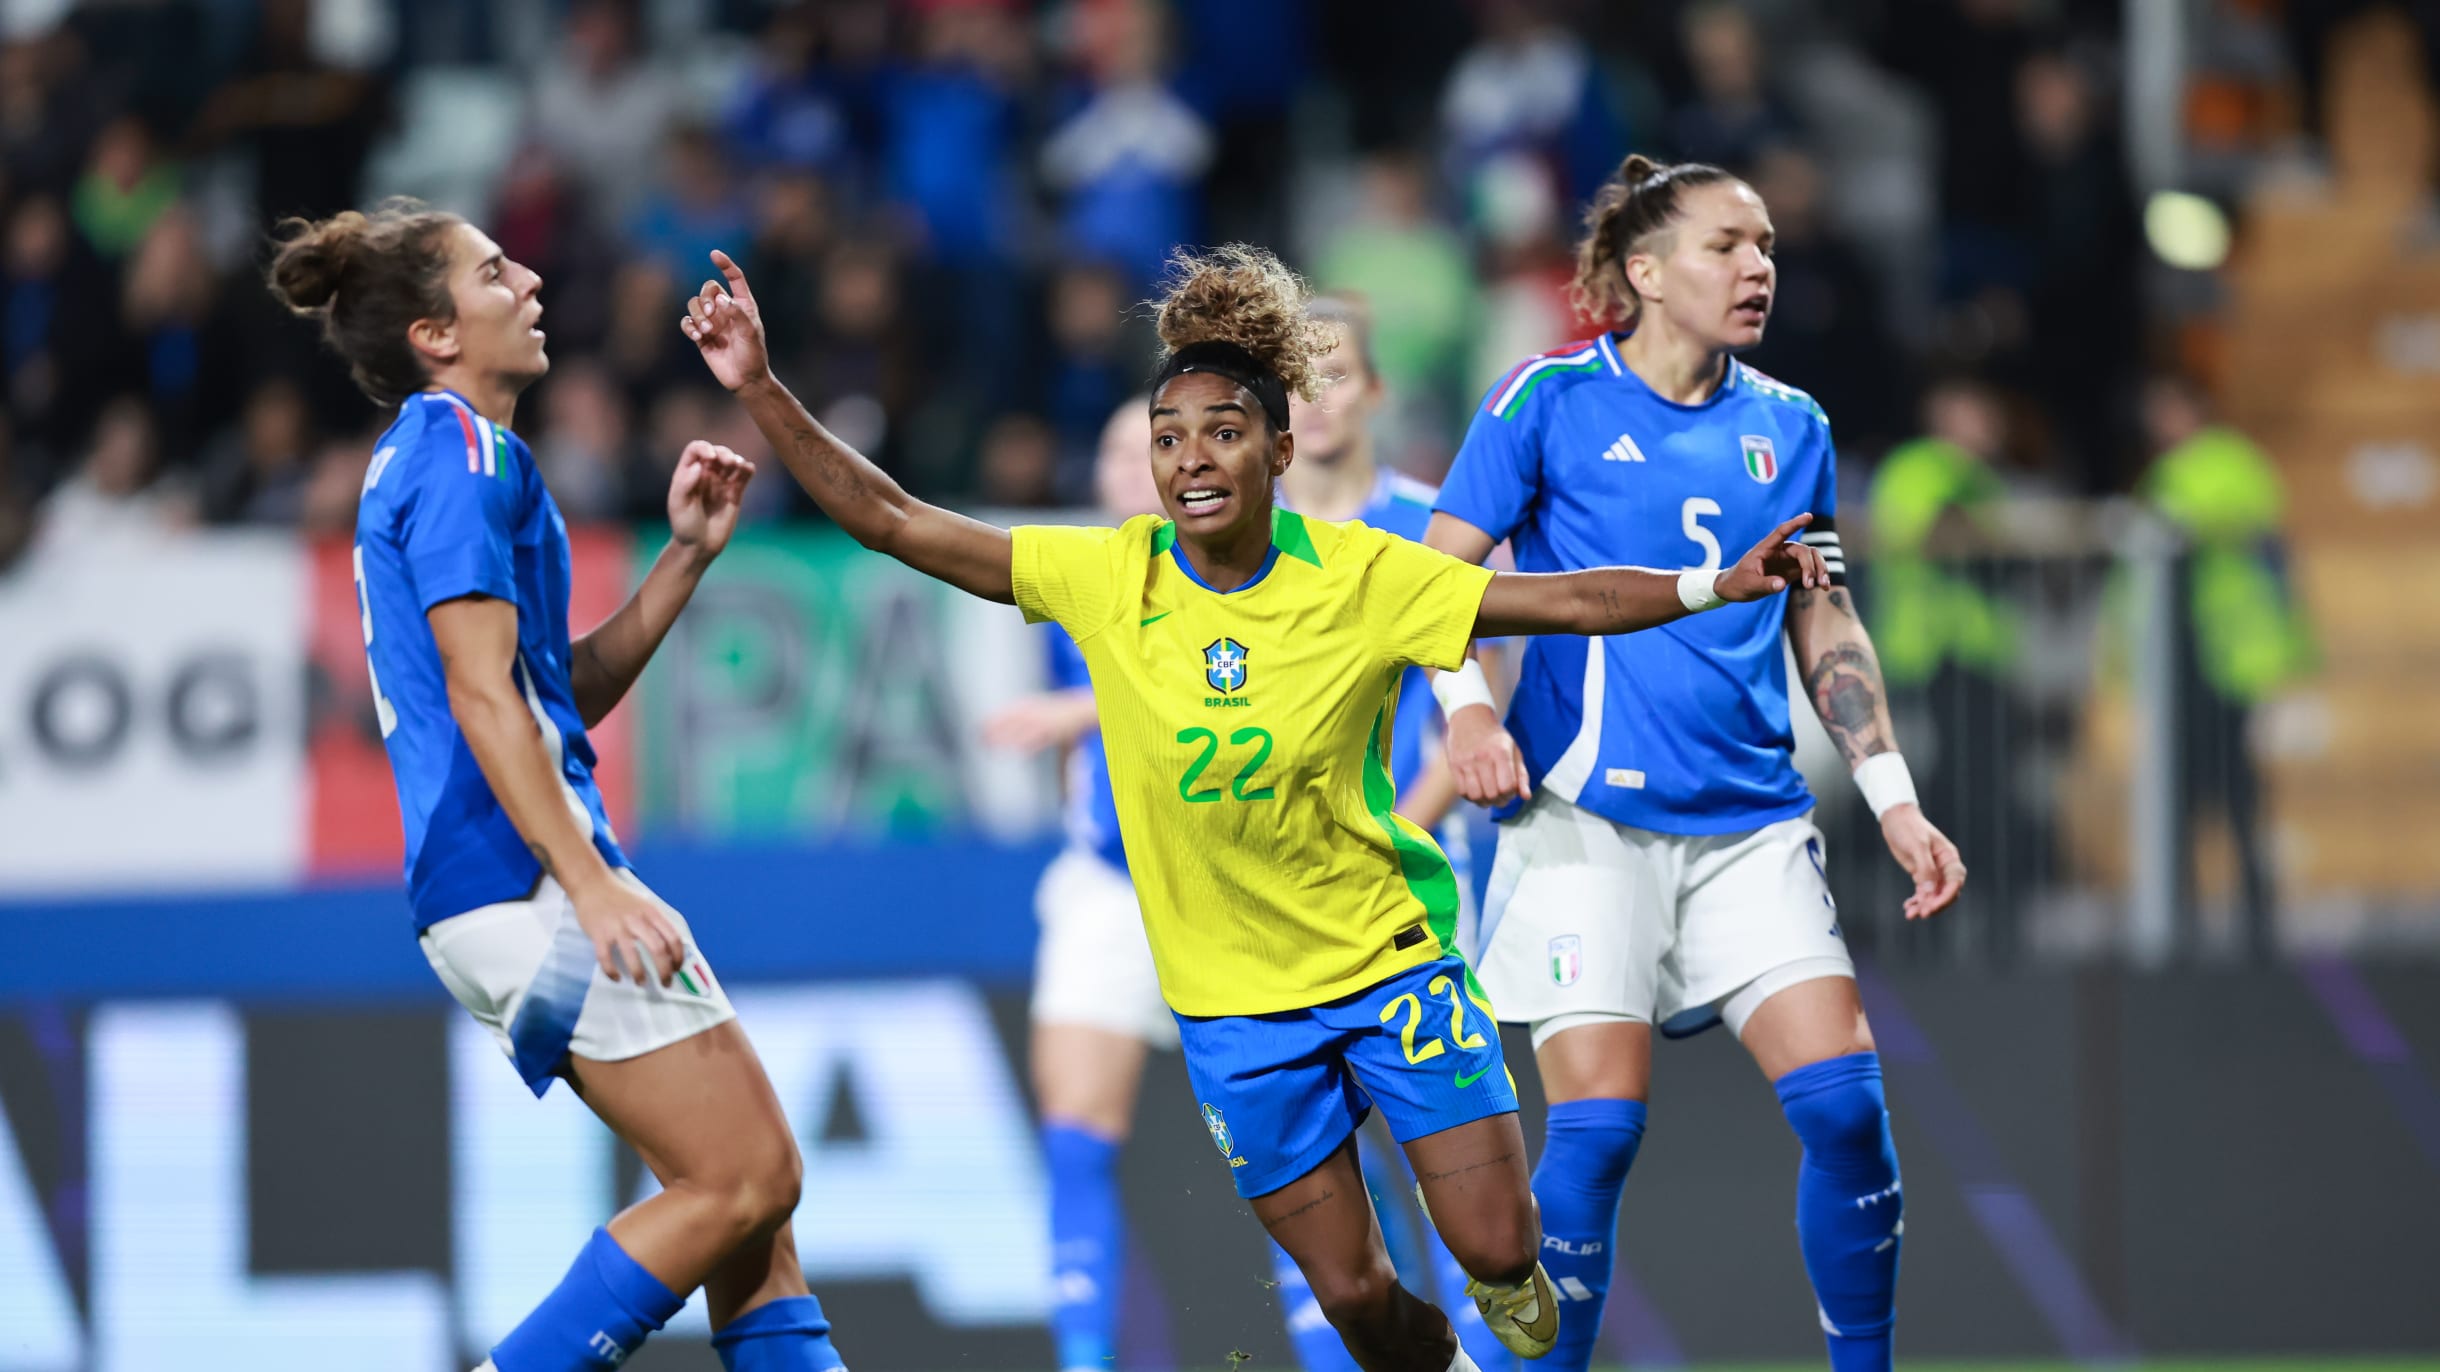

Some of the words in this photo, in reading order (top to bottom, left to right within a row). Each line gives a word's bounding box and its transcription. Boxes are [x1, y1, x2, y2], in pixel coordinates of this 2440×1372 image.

[1682, 496, 1722, 571] 5
[1217, 660, 1235, 668] CBF
[1204, 697, 1252, 708] BRASIL
[1176, 726, 1275, 803] 22
[1379, 975, 1488, 1066] 22
[1542, 1233, 1602, 1256] ALIA
